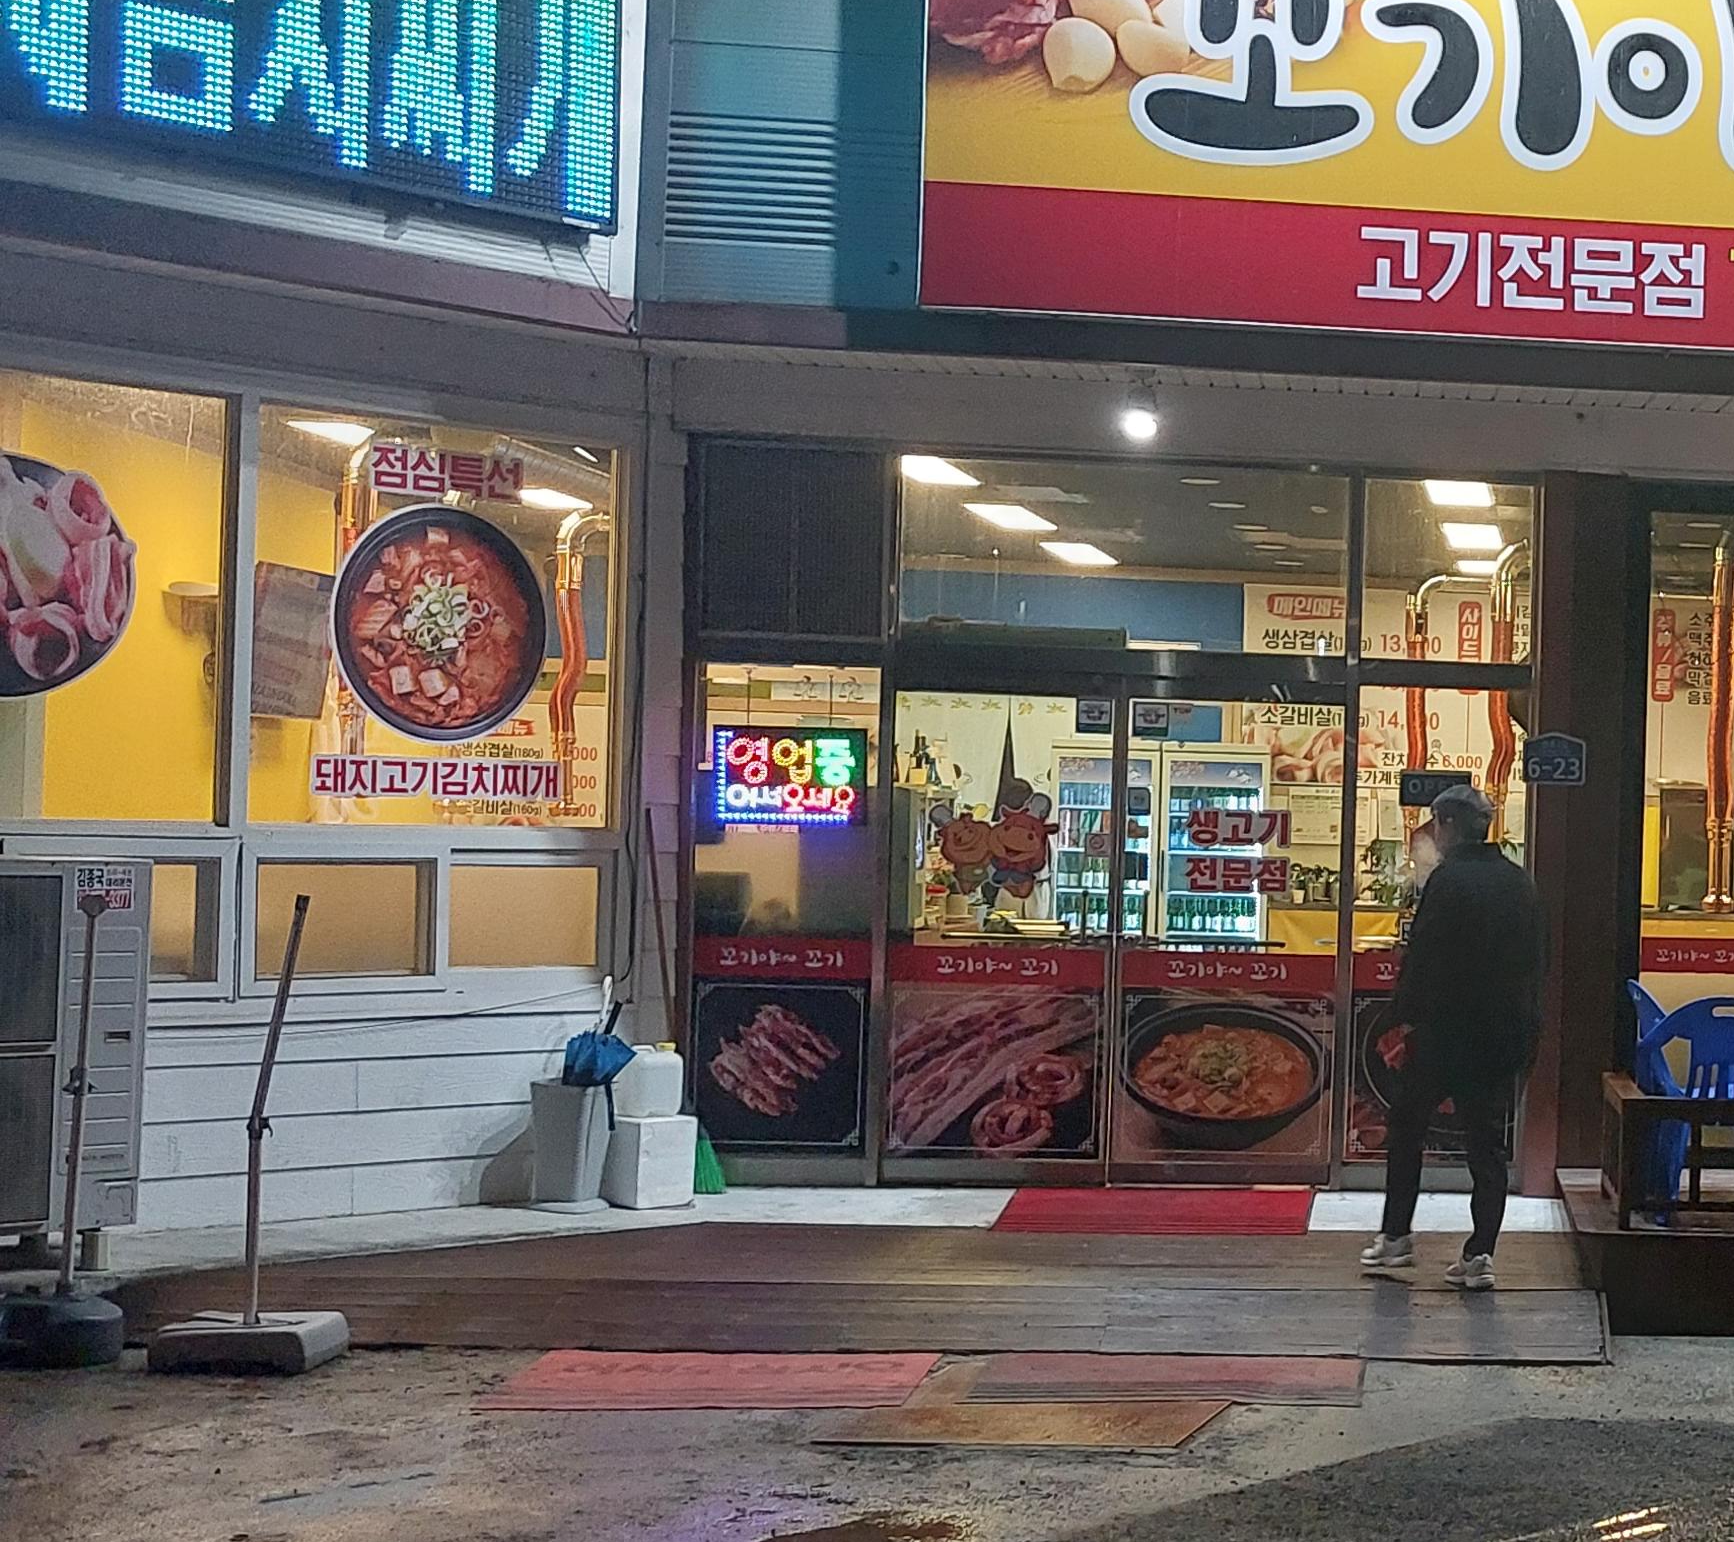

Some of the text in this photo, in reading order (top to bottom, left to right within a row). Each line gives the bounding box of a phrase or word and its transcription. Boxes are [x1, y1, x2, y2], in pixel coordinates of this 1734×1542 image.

[1356, 225, 1706, 319] 고기전문점
[371, 445, 522, 504] 점심특선
[314, 757, 559, 798] 돼지고기김치찌개
[726, 736, 856, 786] 영업중
[1527, 756, 1581, 780] 6-23
[1185, 809, 1290, 847] 생고기
[1184, 857, 1288, 894] 전문점
[804, 949, 844, 968] 꼬기
[1019, 957, 1059, 976] 꼬기
[1249, 962, 1288, 980] 꼬기
